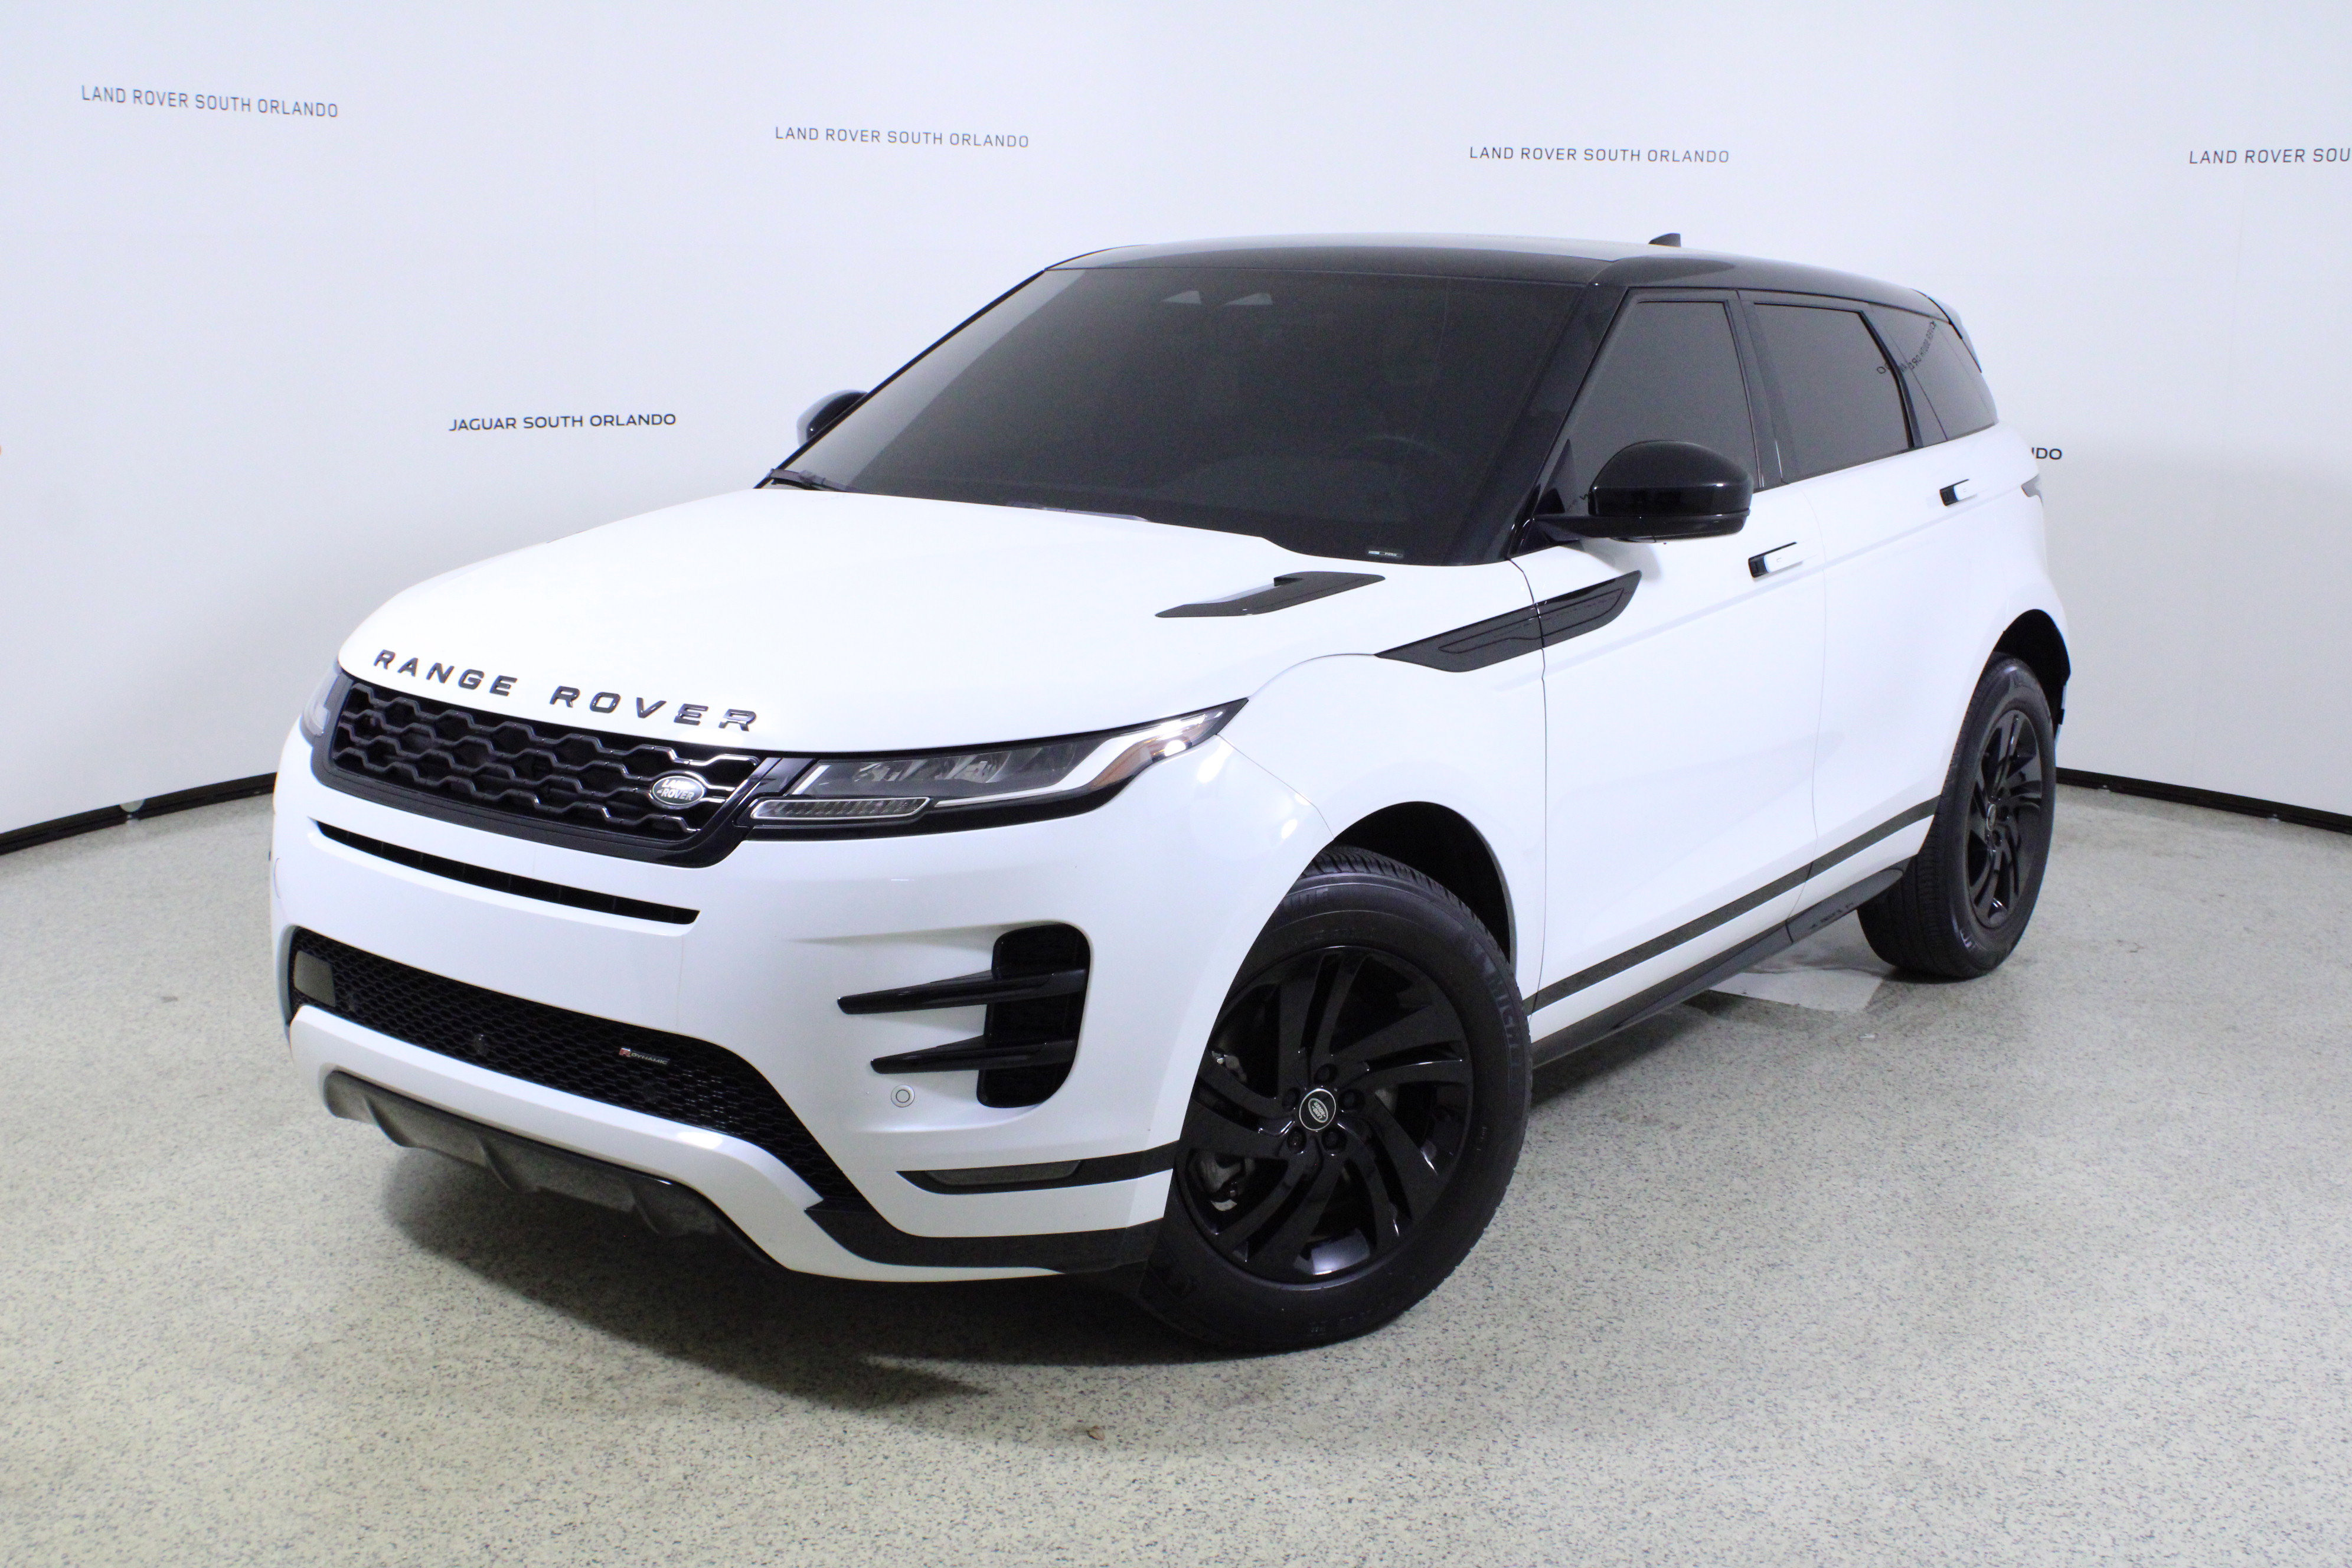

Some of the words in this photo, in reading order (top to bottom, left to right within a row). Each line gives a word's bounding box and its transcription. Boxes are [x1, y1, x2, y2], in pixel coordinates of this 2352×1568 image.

[81, 85, 126, 103] LAND
[132, 89, 189, 108] ROVER
[195, 94, 251, 112] SOUTH
[257, 98, 338, 117] ORLANDO
[775, 126, 818, 141] LAND
[826, 128, 880, 142] ROVER
[887, 130, 943, 145] SOUTH
[950, 133, 1028, 148] ORLANDO
[1470, 146, 1514, 159] LAND
[1521, 147, 1577, 161] ROVER
[1584, 148, 1641, 162] SOUTH
[1648, 149, 1729, 163] ORLANDO
[2189, 149, 2237, 164] LAND
[2245, 148, 2305, 164] ROVER
[449, 417, 517, 432] JAGUAR
[524, 415, 583, 429] SOUTH
[590, 413, 677, 427] ORLANDO
[373, 649, 518, 697] RANGE
[549, 685, 757, 731] ROVER
[661, 788, 695, 801] ROVER
[631, 1053, 668, 1064] DYNAMIC
[1312, 1108, 1322, 1119] LAND
[1314, 1101, 1325, 1116] ROVER
